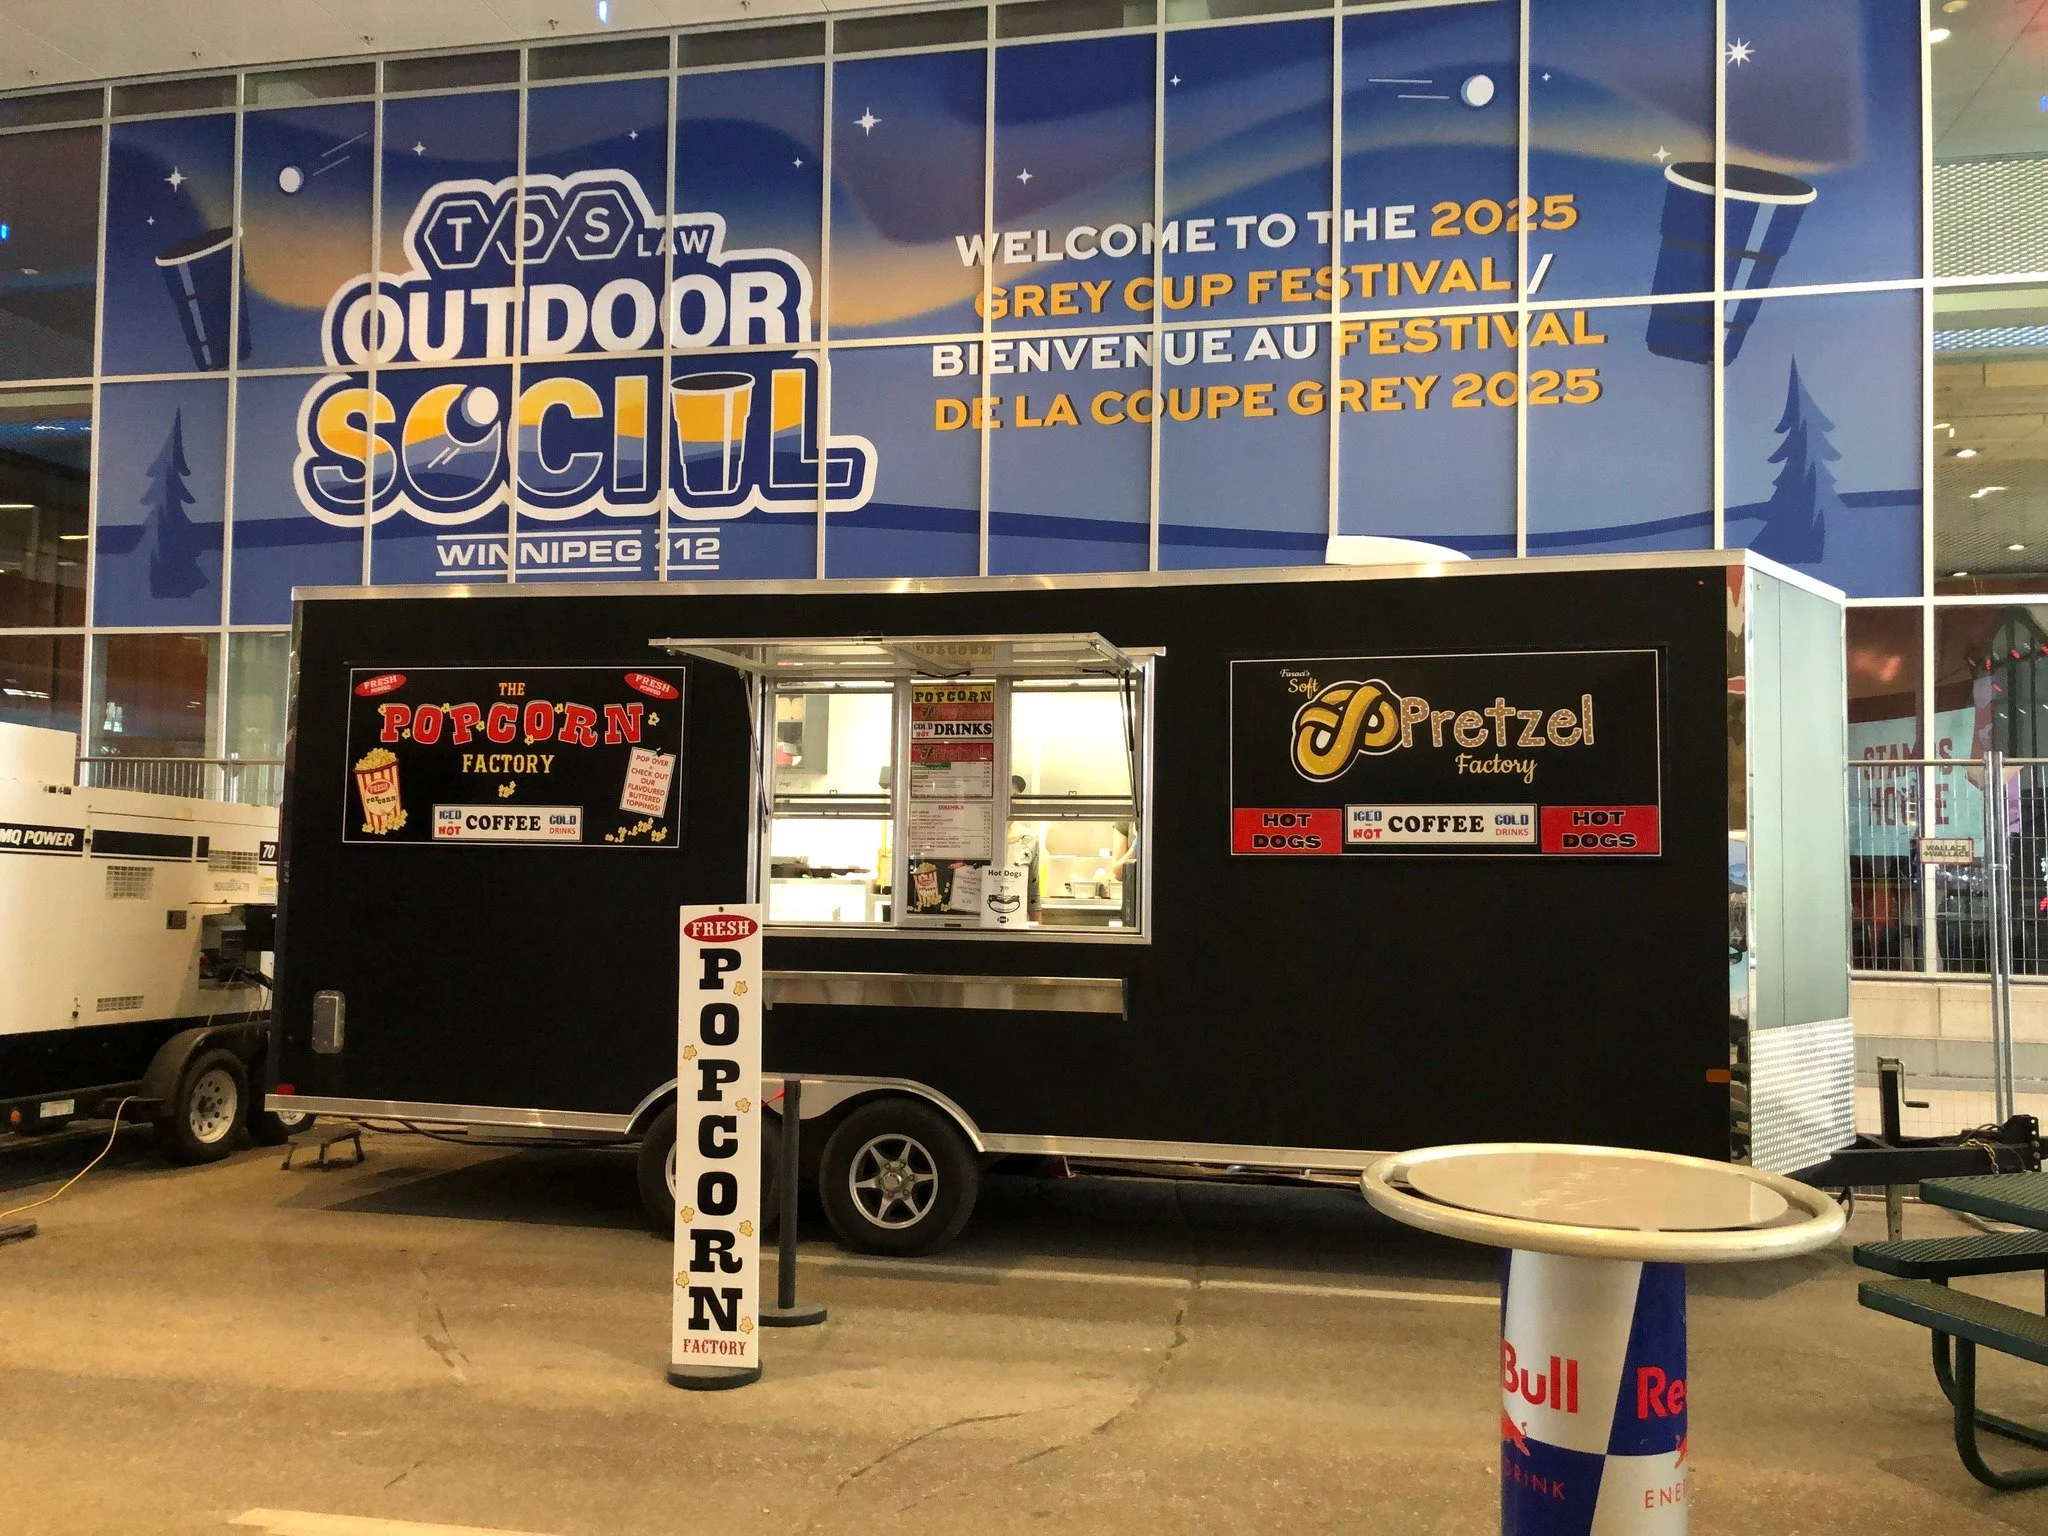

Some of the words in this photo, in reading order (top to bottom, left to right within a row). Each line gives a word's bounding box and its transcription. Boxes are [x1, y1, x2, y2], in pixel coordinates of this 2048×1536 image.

[446, 206, 611, 253] TDS
[637, 229, 711, 257] LAW
[955, 218, 1217, 267] WELCOME
[1225, 213, 1296, 251] TO
[1307, 205, 1416, 244] THE
[1430, 194, 1578, 238] 2025
[974, 280, 1111, 321] GREY
[1124, 272, 1233, 312] CUP
[1248, 258, 1512, 303] FESTIVAL
[341, 271, 788, 366] OUTDOOR
[932, 326, 1235, 377] BIENVENUE
[1244, 325, 1317, 361] AU
[1340, 308, 1607, 356] FESTIVAL
[935, 395, 1001, 431] DE
[1016, 390, 1078, 427] LA
[1091, 382, 1277, 424] COUPE
[1287, 374, 1438, 416] GREY
[1452, 368, 1603, 409] 2025
[312, 368, 854, 505] SOCIL
[437, 539, 642, 567] WINNIPEG
[363, 675, 397, 690] FRESH
[499, 682, 526, 696] THE
[635, 674, 671, 693] FRESH
[1288, 677, 1320, 699] Soft
[915, 690, 992, 703] POPCORN
[380, 700, 644, 748] POPCORN
[933, 723, 992, 736] DRINKS
[1400, 694, 1595, 748] Pretzel
[462, 754, 556, 774] FACTORY
[636, 754, 650, 763] POP
[652, 757, 669, 767] OVER
[1864, 738, 1953, 780] STAMS
[631, 767, 653, 778] CHECK
[654, 772, 668, 780] OUT
[1455, 752, 1537, 784] Factory
[627, 783, 665, 796] FLAVOURED
[640, 777, 656, 786] OUR
[626, 799, 661, 812] TOPPINGS!
[629, 791, 660, 804] BUTTERED
[1868, 783, 1949, 826] HOUE
[439, 810, 462, 820] ICED
[465, 815, 541, 831] COFFEE
[549, 815, 577, 825] COLD
[1262, 813, 1312, 828] HOT
[1353, 810, 1383, 822] ICED
[1494, 814, 1529, 826] COLD
[1572, 811, 1626, 827] HOT
[438, 826, 461, 836] HOT
[1388, 815, 1485, 833] COFFEE
[1495, 828, 1529, 836] DRINKS
[0, 828, 22, 846] MQ
[23, 829, 75, 847] POWER
[1252, 833, 1322, 850] DOGS
[1353, 828, 1383, 839] HOT
[1562, 833, 1638, 849] DOGS
[262, 844, 276, 859] 70
[988, 869, 1002, 877] Hot
[1004, 869, 1022, 879] Dogs
[691, 920, 751, 937] FRESH
[687, 947, 743, 1332] POPCORN
[683, 1339, 747, 1356] FACTORY
[1502, 1338, 1578, 1414] Bull
[1637, 1366, 1687, 1420] Re
[1502, 1456, 1565, 1501] DRINK
